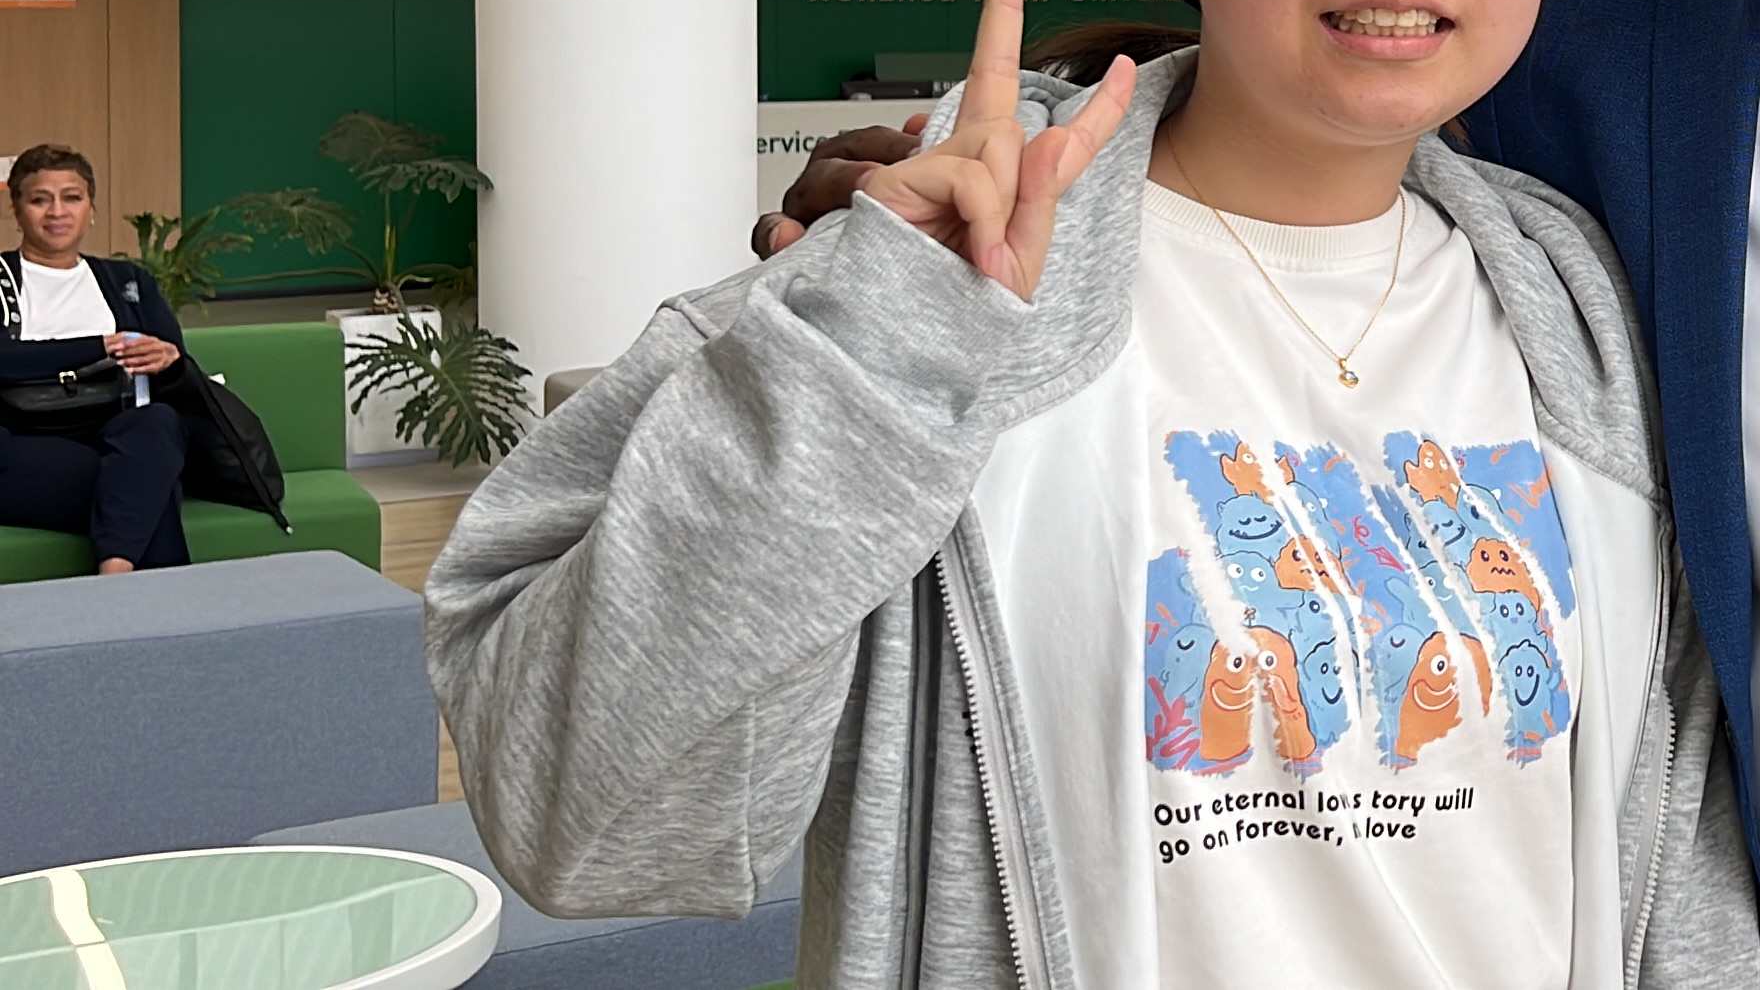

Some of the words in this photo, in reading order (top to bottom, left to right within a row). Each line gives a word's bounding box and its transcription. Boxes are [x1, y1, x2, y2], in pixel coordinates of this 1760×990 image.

[1154, 803, 1201, 826] Our
[1212, 790, 1305, 816] eternal
[1435, 787, 1474, 811] will
[1159, 838, 1190, 864] go
[1203, 829, 1229, 851] on
[1236, 818, 1344, 847] forever,
